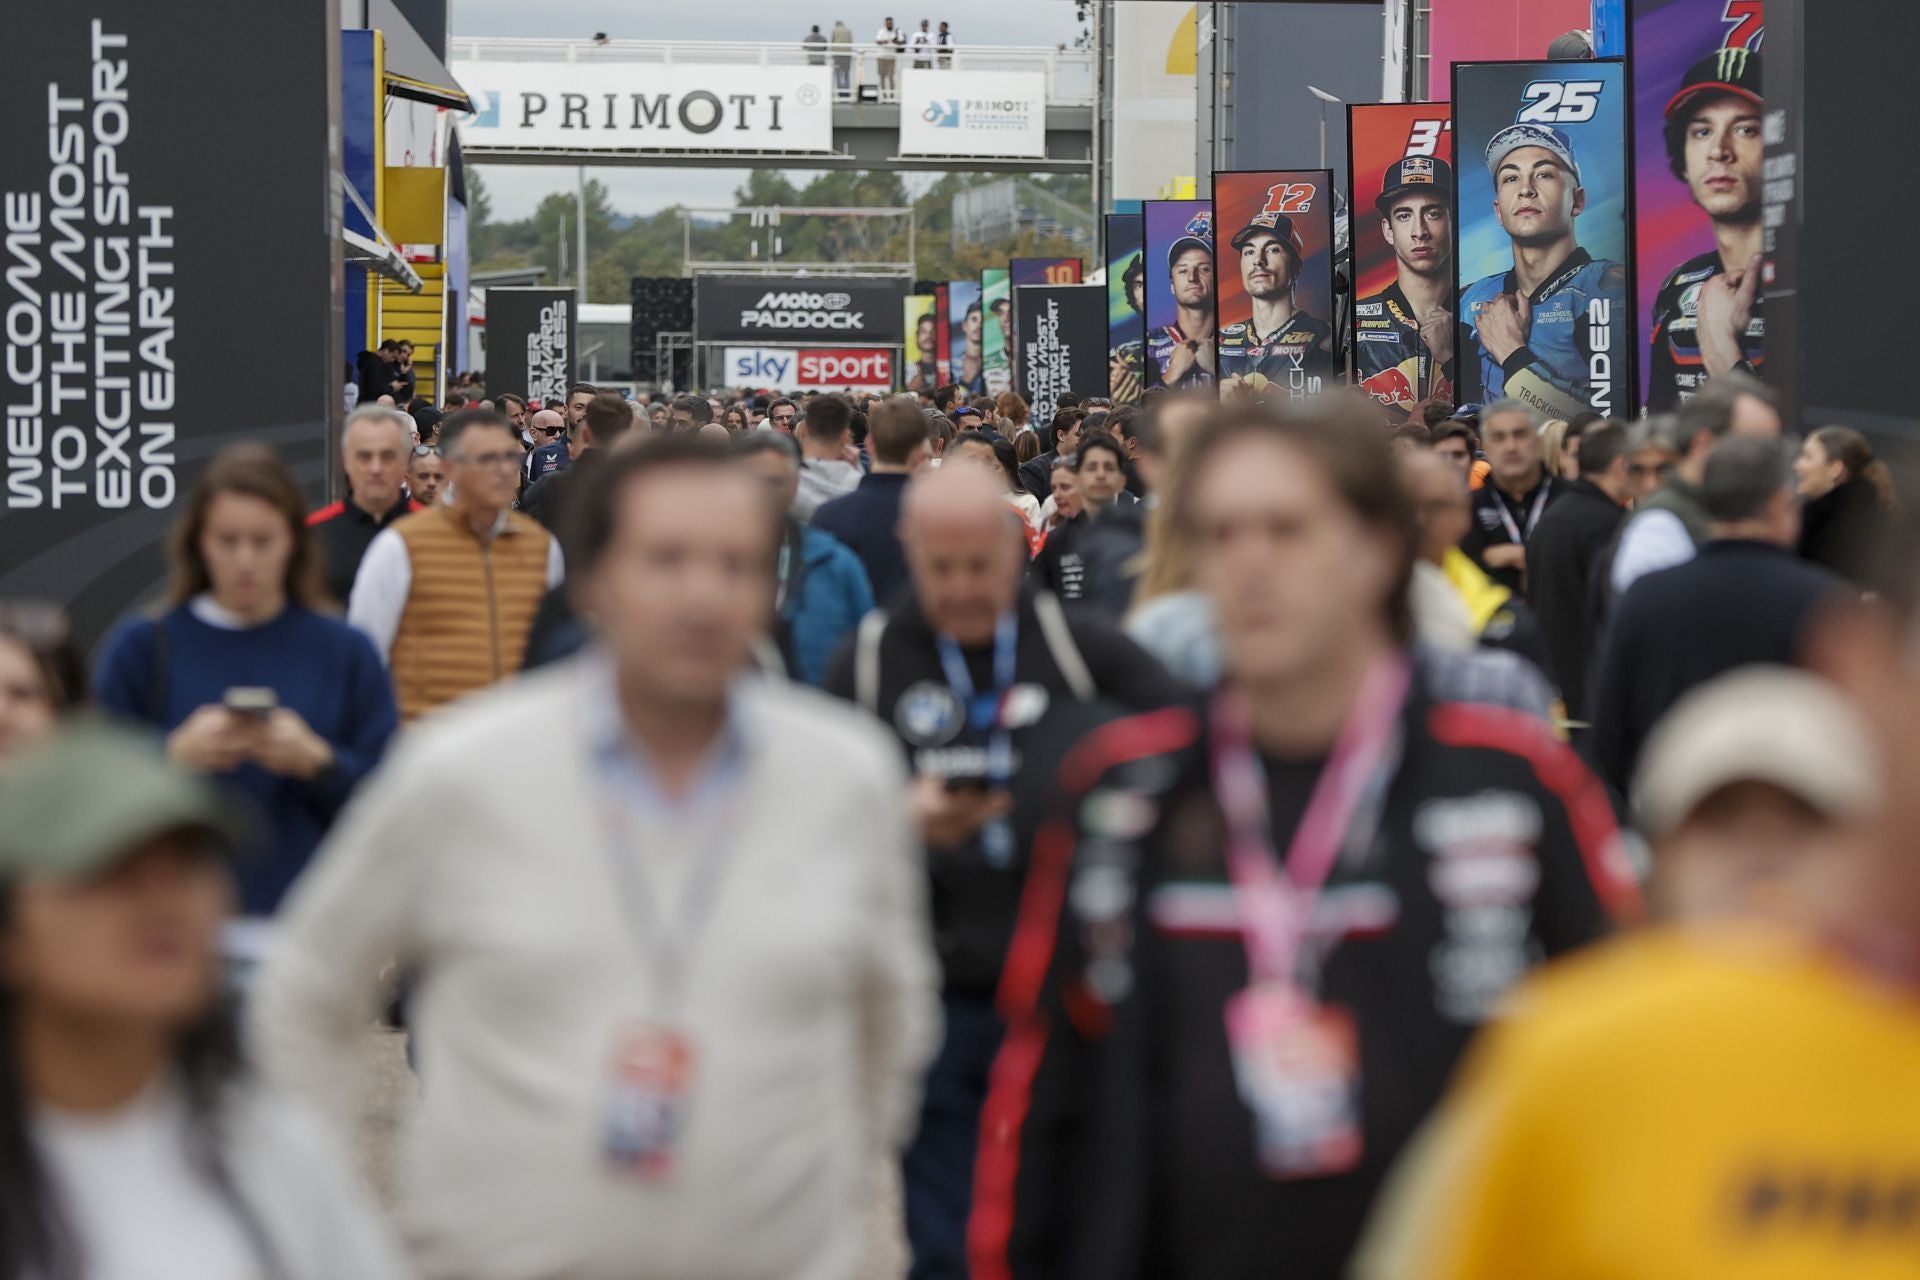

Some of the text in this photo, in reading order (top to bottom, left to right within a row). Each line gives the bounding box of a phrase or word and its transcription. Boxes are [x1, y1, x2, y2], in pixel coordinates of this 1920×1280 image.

[1722, 0, 1764, 52] 7
[519, 89, 783, 135] PRIMOTI
[965, 100, 1029, 112] PRIMOTI
[1515, 80, 1604, 125] 25
[1262, 183, 1316, 213] 12
[1185, 211, 1213, 239] 4
[92, 19, 131, 508] EXCITING SPORT
[1045, 266, 1073, 285] 10
[49, 83, 87, 509] TO THE MOST
[756, 291, 851, 309] MotoGP
[741, 310, 864, 329] PADDOCK
[1037, 314, 1048, 365] MOST
[1047, 298, 1059, 351] SPORT
[7, 193, 43, 508] WELCOME
[139, 205, 175, 509] ON EARTH
[737, 351, 889, 384] sky sport
[1038, 366, 1049, 399] THE
